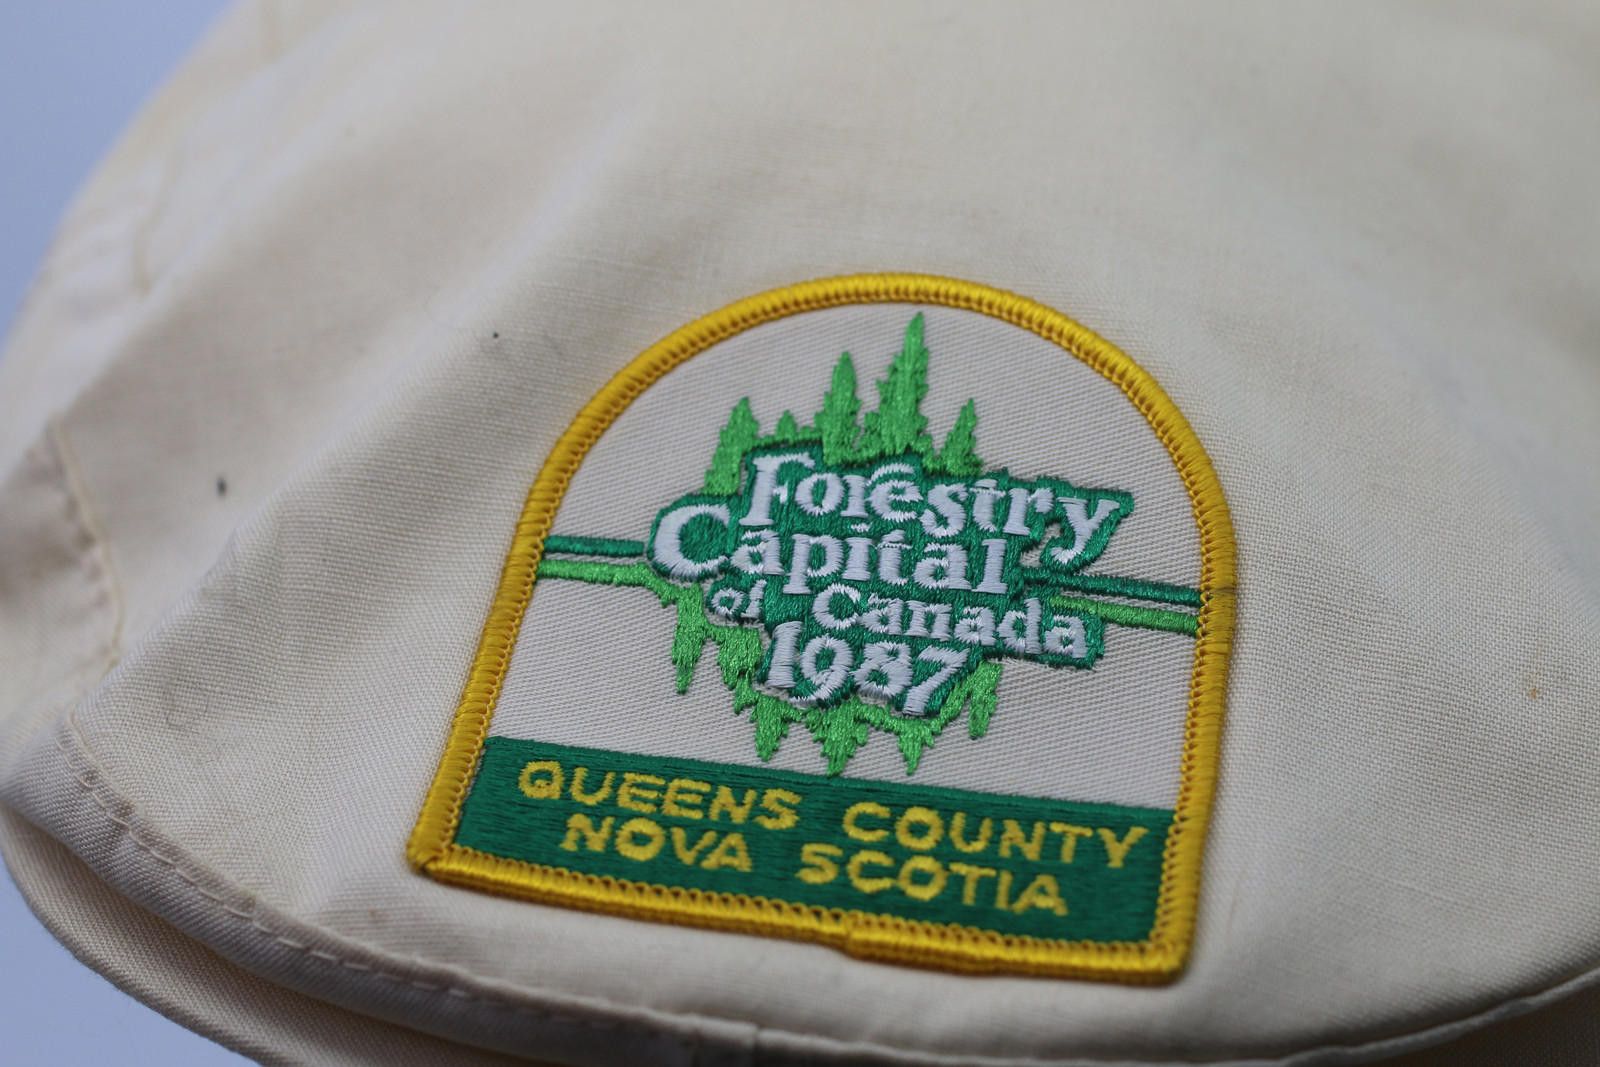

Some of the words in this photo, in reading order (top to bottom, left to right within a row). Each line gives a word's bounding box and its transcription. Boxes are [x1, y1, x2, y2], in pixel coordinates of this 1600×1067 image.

[653, 502, 1009, 595] Capital
[739, 451, 1120, 565] Forestry
[711, 579, 766, 620] of
[811, 582, 1088, 659] Canada
[764, 620, 970, 717] 1987
[518, 760, 801, 831] QUEENS
[842, 801, 1148, 867] COUNTY
[559, 813, 753, 872] NOVA
[795, 843, 1068, 916] SCOTIA
